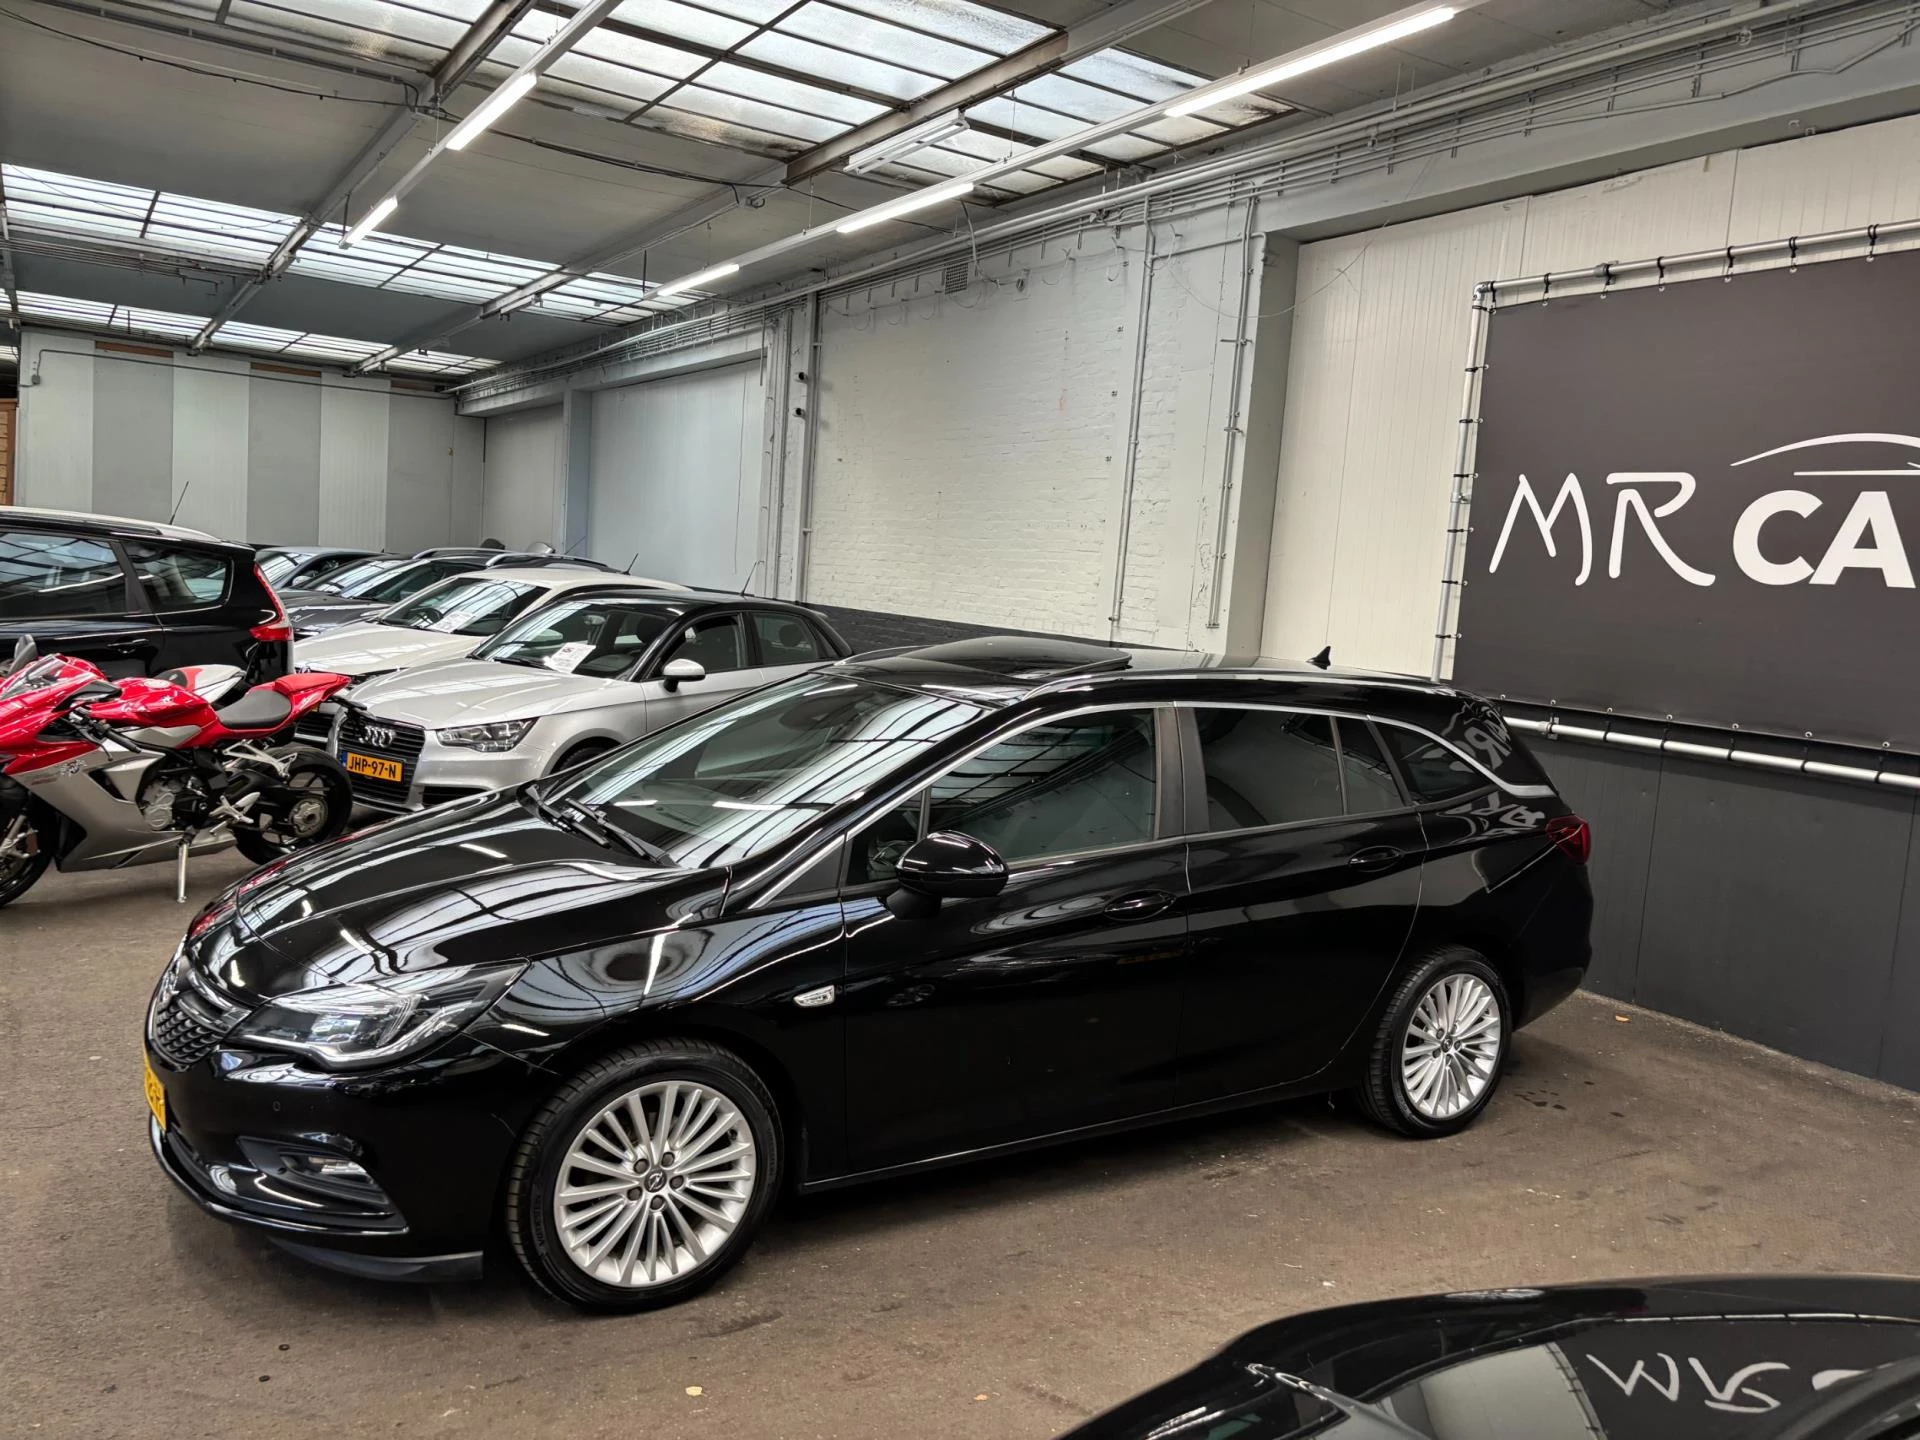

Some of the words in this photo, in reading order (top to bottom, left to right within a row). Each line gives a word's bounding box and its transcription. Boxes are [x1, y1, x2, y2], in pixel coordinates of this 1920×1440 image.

[1490, 472, 1716, 586] MR
[1732, 489, 1917, 588] CA
[348, 756, 397, 779] JHP-97-N
